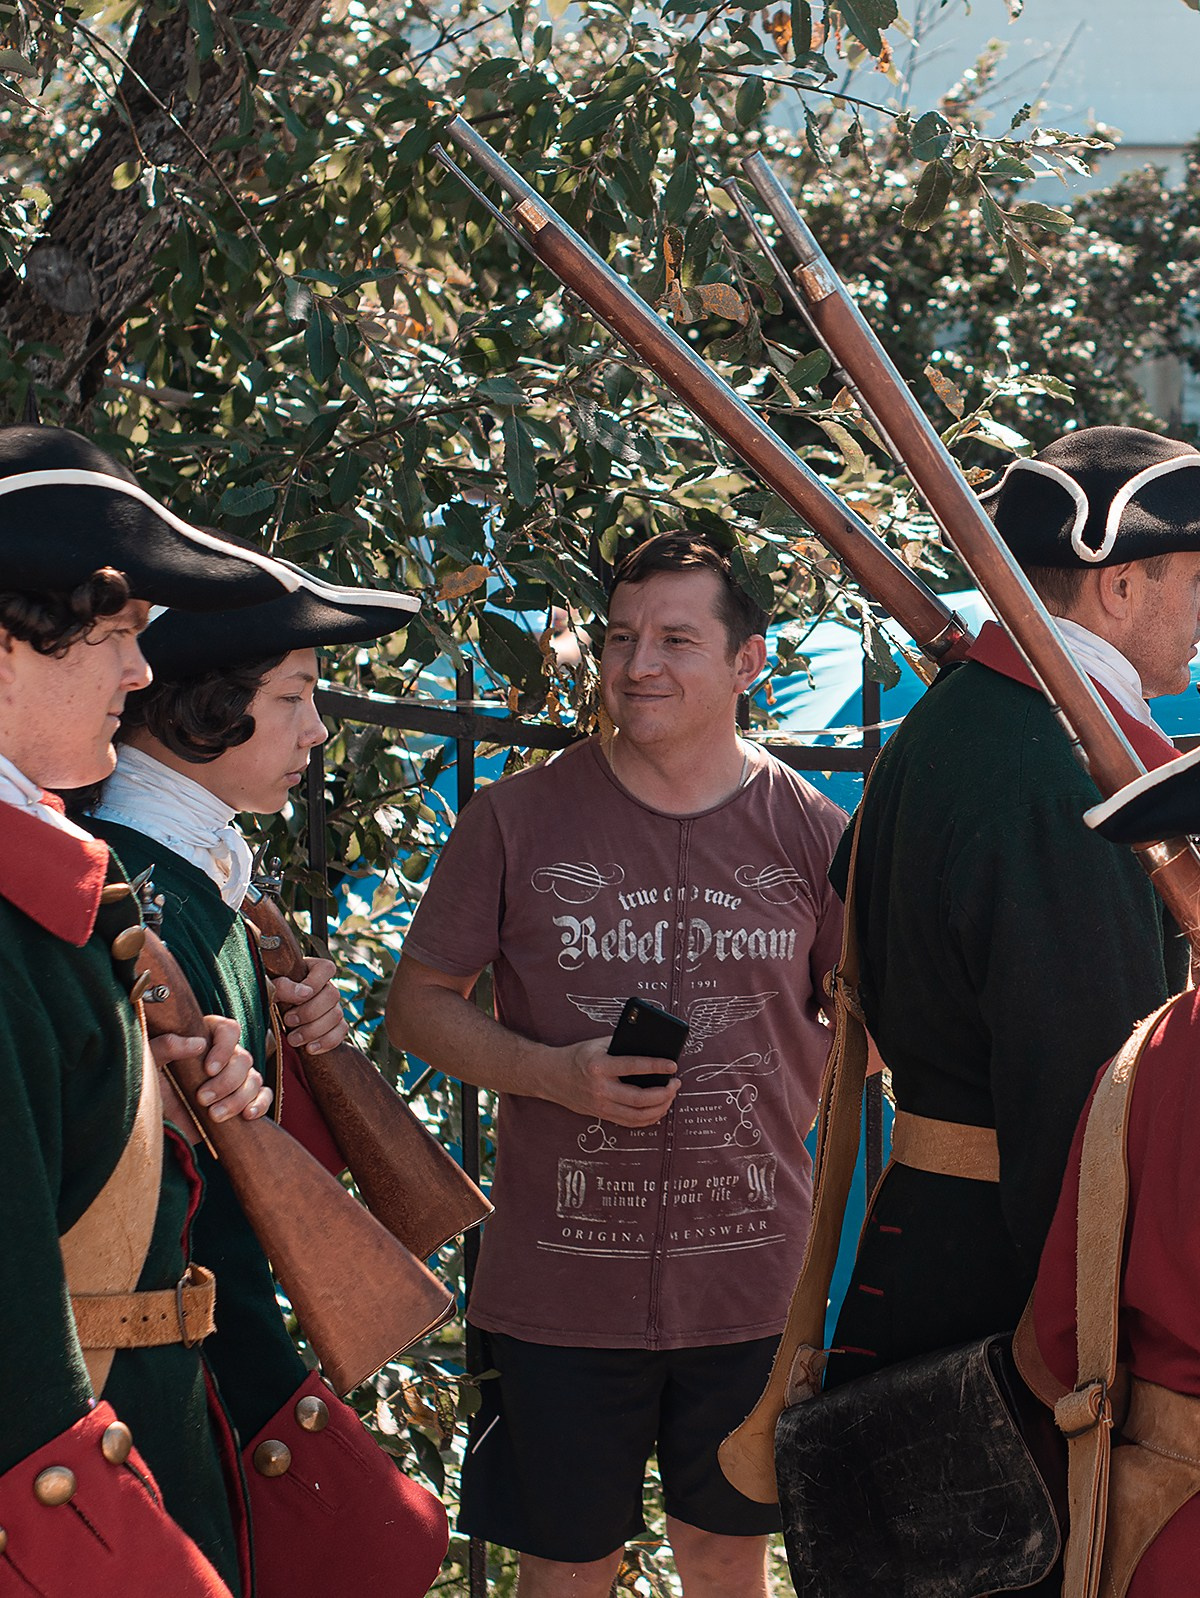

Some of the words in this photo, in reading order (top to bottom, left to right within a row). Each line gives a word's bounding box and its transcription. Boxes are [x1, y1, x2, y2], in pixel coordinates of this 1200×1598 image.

[618, 885, 658, 911] true
[704, 887, 742, 911] rare
[552, 915, 669, 970] Rebel
[675, 917, 798, 973] Dream
[679, 1105, 723, 1113] adventure
[696, 1116, 713, 1124] live
[563, 1169, 586, 1209] 19
[596, 1176, 635, 1192] Learn
[643, 1179, 656, 1192] to
[705, 1175, 740, 1188] every
[602, 1192, 647, 1208] minute
[673, 1192, 704, 1208] your
[711, 1187, 732, 1202] life
[561, 1227, 655, 1243] ORIGINA
